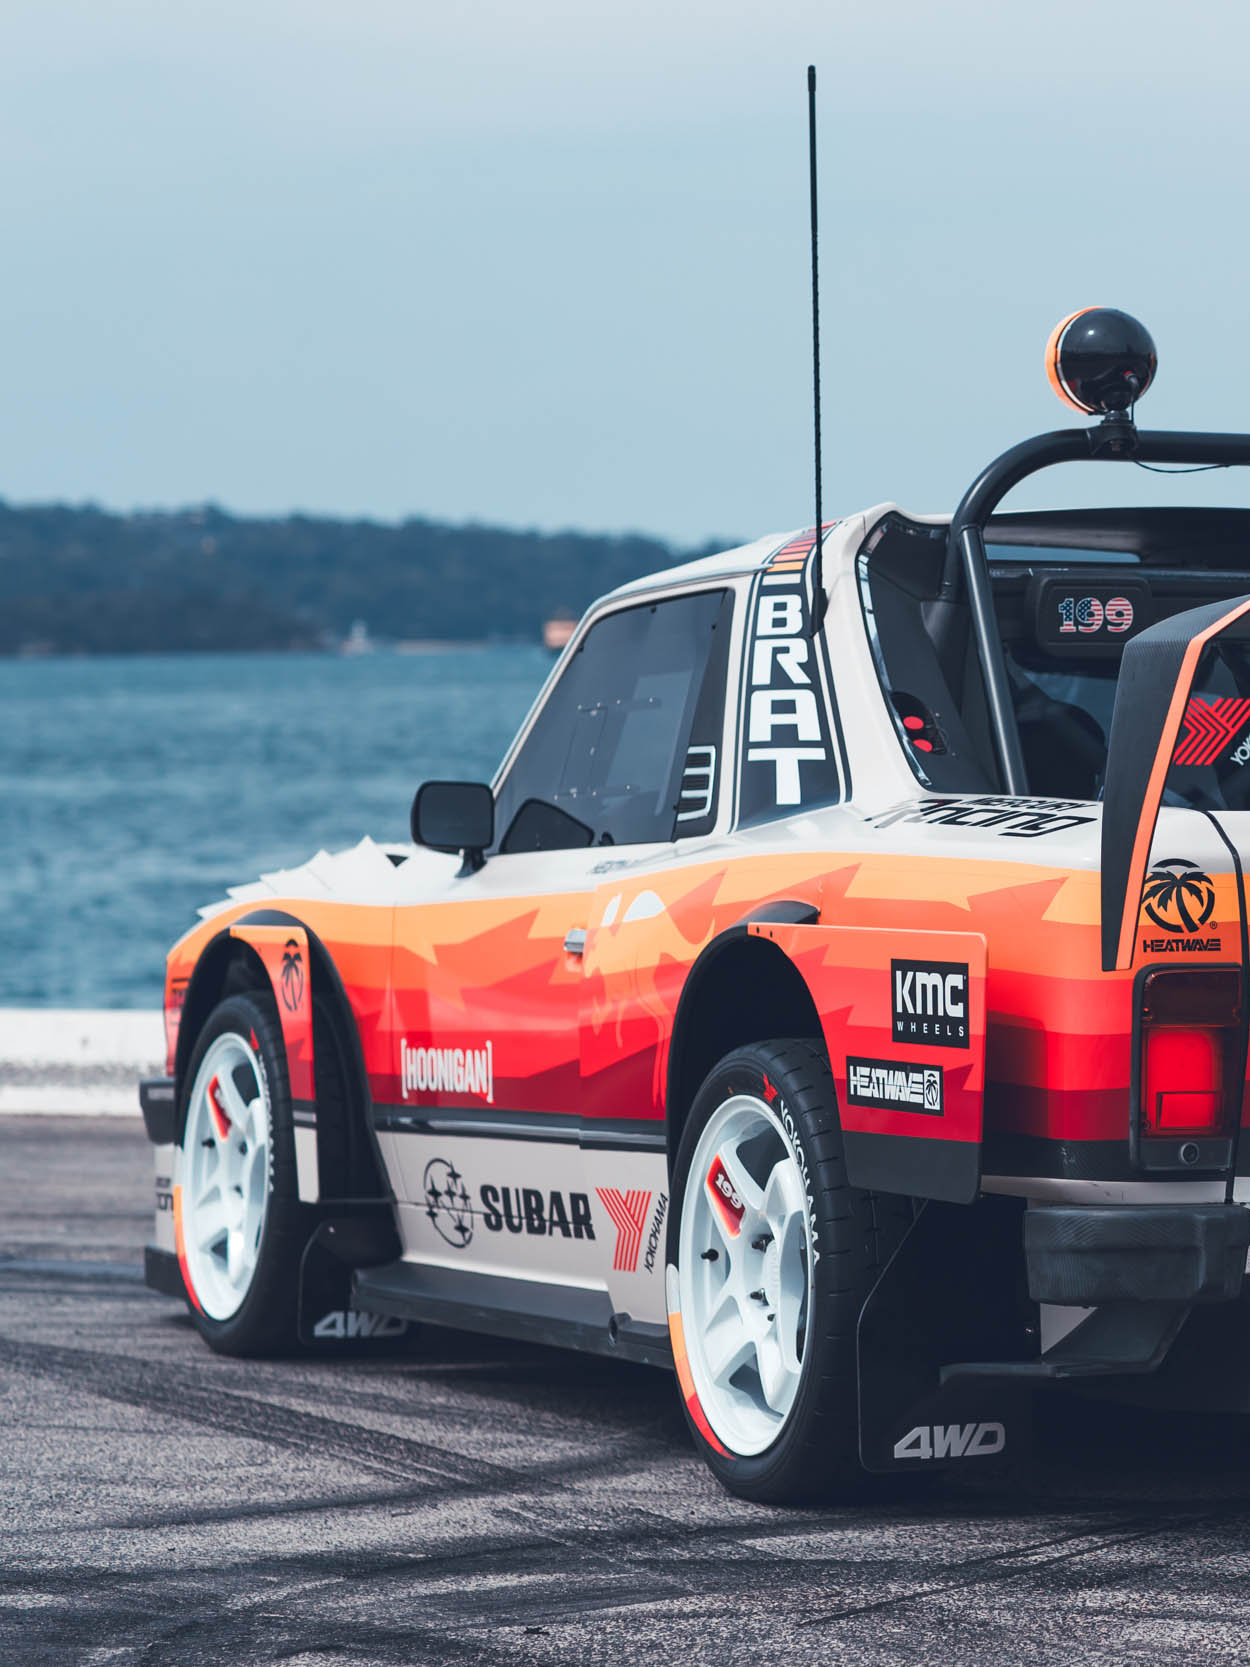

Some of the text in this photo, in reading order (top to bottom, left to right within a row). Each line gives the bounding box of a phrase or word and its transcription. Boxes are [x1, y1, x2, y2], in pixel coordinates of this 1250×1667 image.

[1058, 597, 1134, 632] 199
[748, 594, 826, 804] BRAT
[1143, 938, 1222, 953] HEATWAVE
[896, 1020, 964, 1037] WHEELS
[849, 1065, 924, 1104] HEATWAVE
[714, 1173, 743, 1209] 199
[643, 1192, 669, 1274] YOKOHAMA
[893, 1422, 1006, 1460] 4WD
